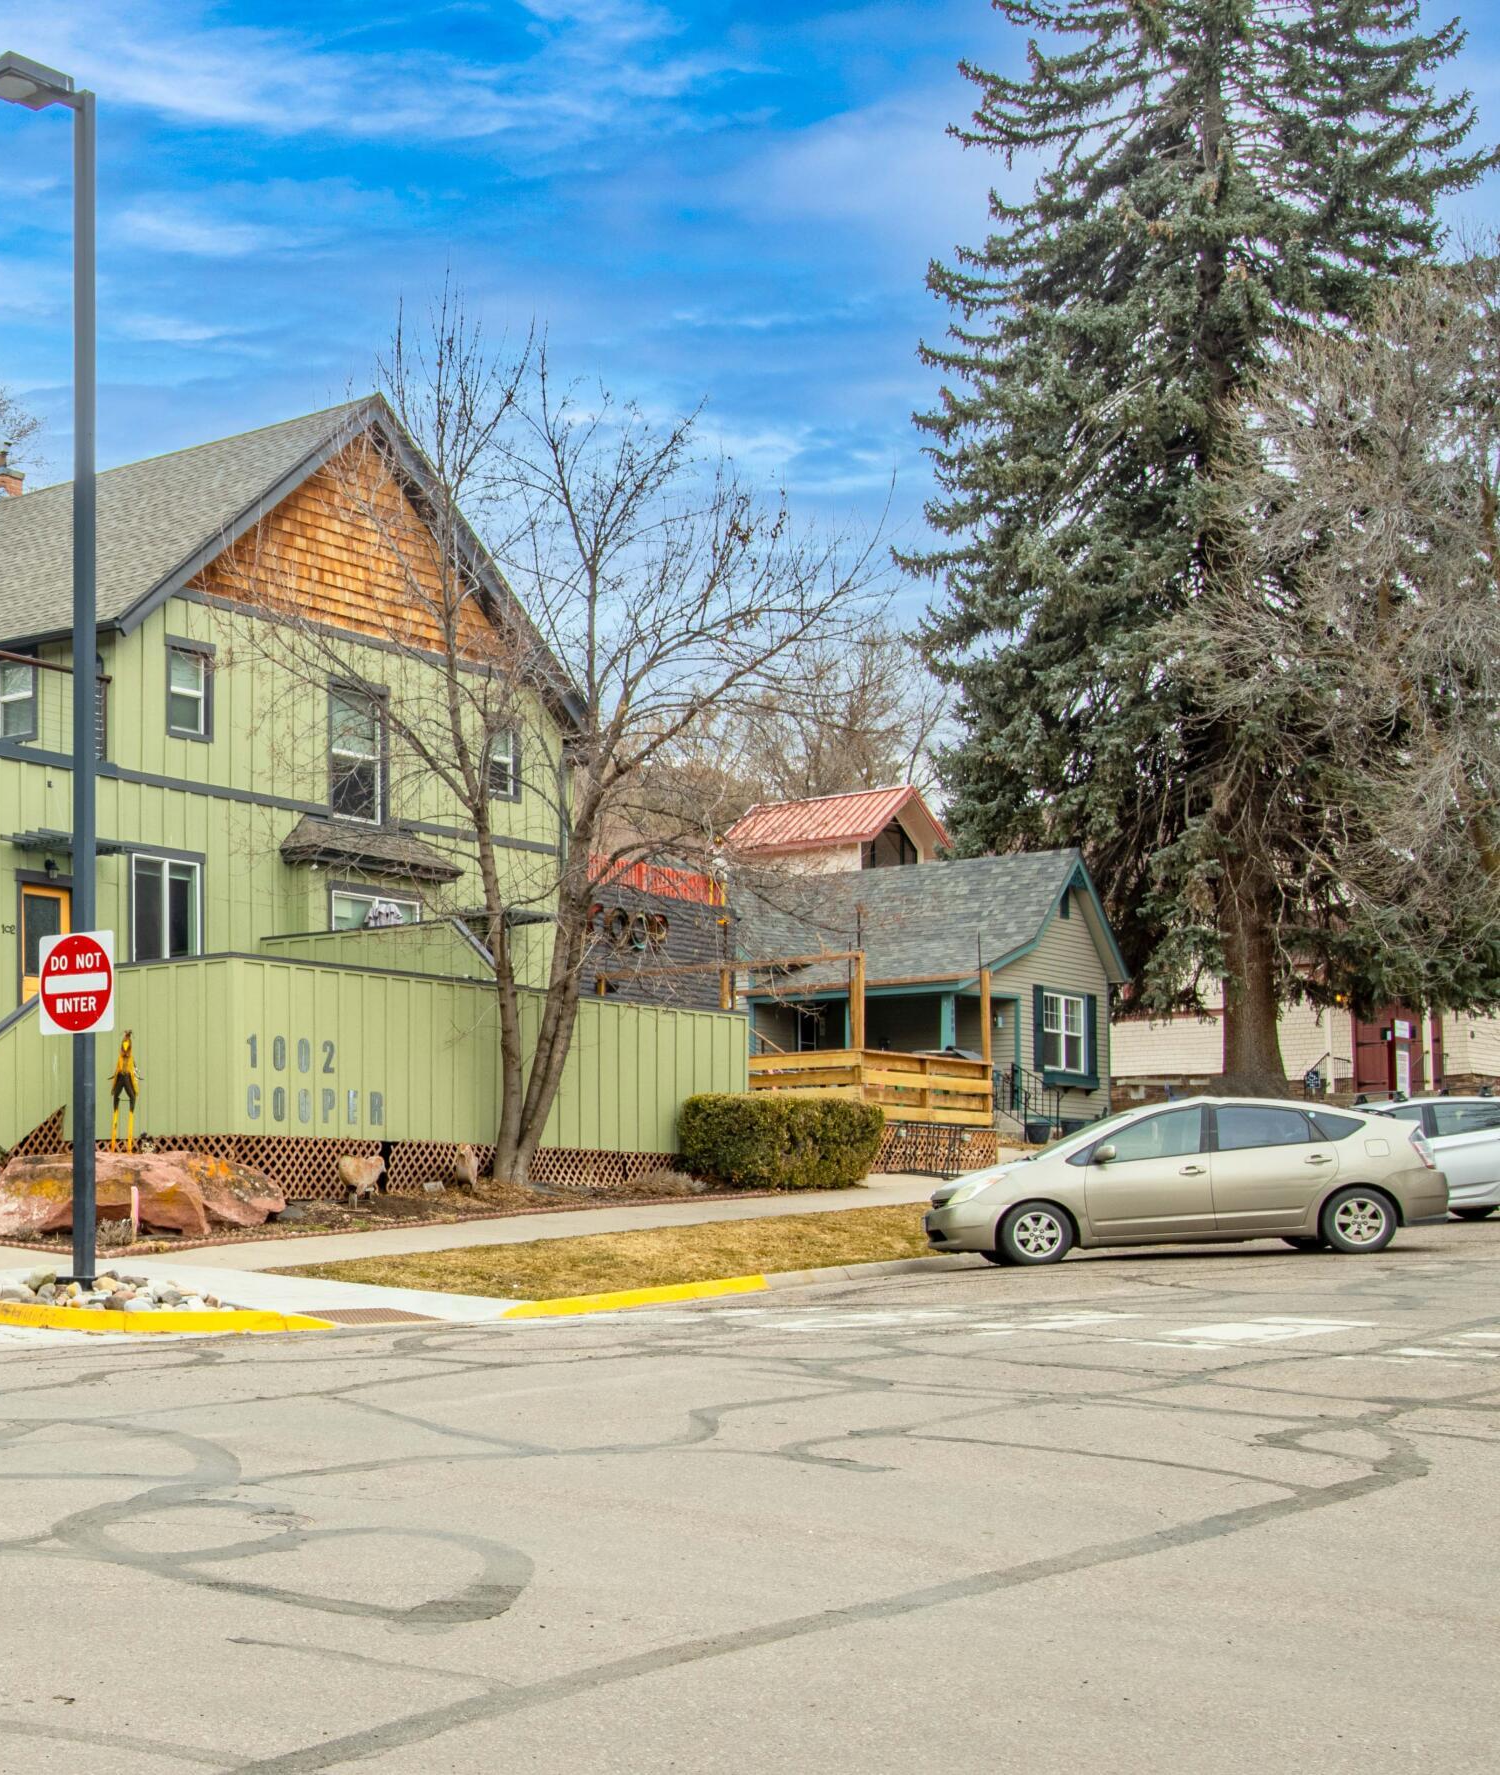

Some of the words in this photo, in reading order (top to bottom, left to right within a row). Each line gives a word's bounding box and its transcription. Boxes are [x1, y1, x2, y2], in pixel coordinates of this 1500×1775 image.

[1, 924, 16, 935] 102
[50, 955, 69, 972] DO
[75, 952, 102, 970] NOT
[246, 1034, 335, 1074] 1002
[247, 1083, 383, 1126] COOPER
